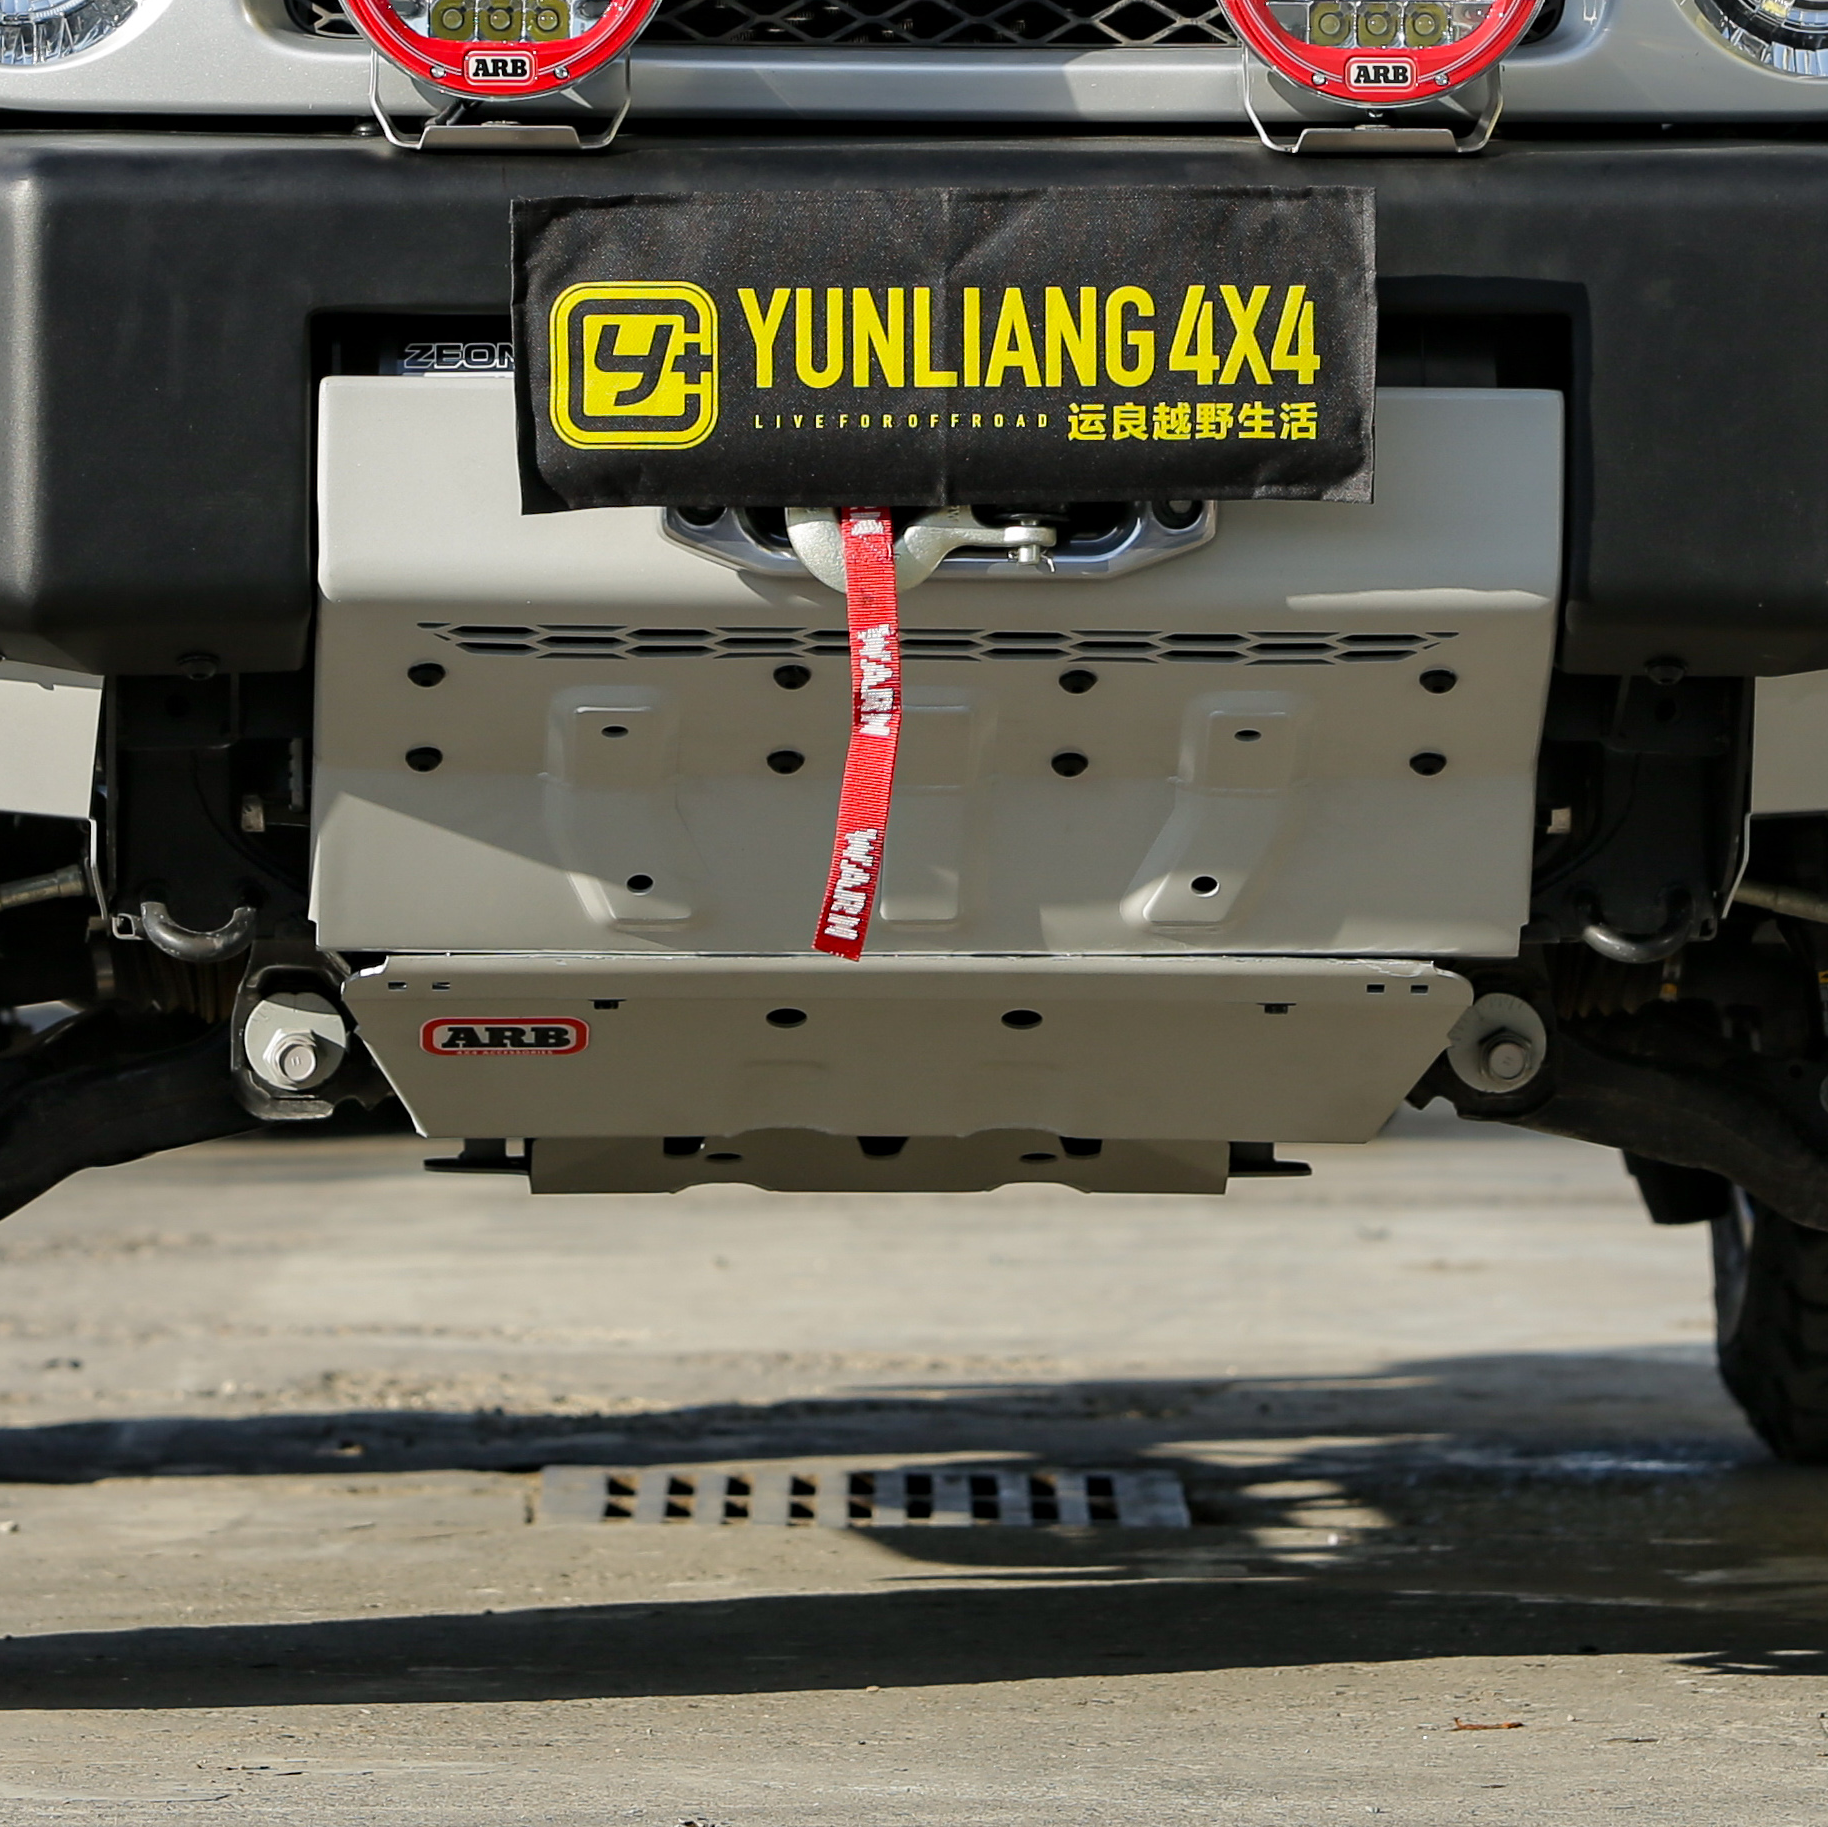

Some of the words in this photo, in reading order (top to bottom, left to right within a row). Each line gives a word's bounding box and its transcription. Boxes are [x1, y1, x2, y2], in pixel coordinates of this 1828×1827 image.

[473, 58, 528, 78] ARB
[1354, 66, 1409, 86] ARB
[739, 286, 1157, 388] YUNLIANG
[1169, 284, 1321, 385] 4X4
[1067, 401, 1318, 441] 运良越野生活
[857, 623, 896, 736] WARN
[824, 828, 878, 941] WARN
[441, 1026, 571, 1048] ARB
